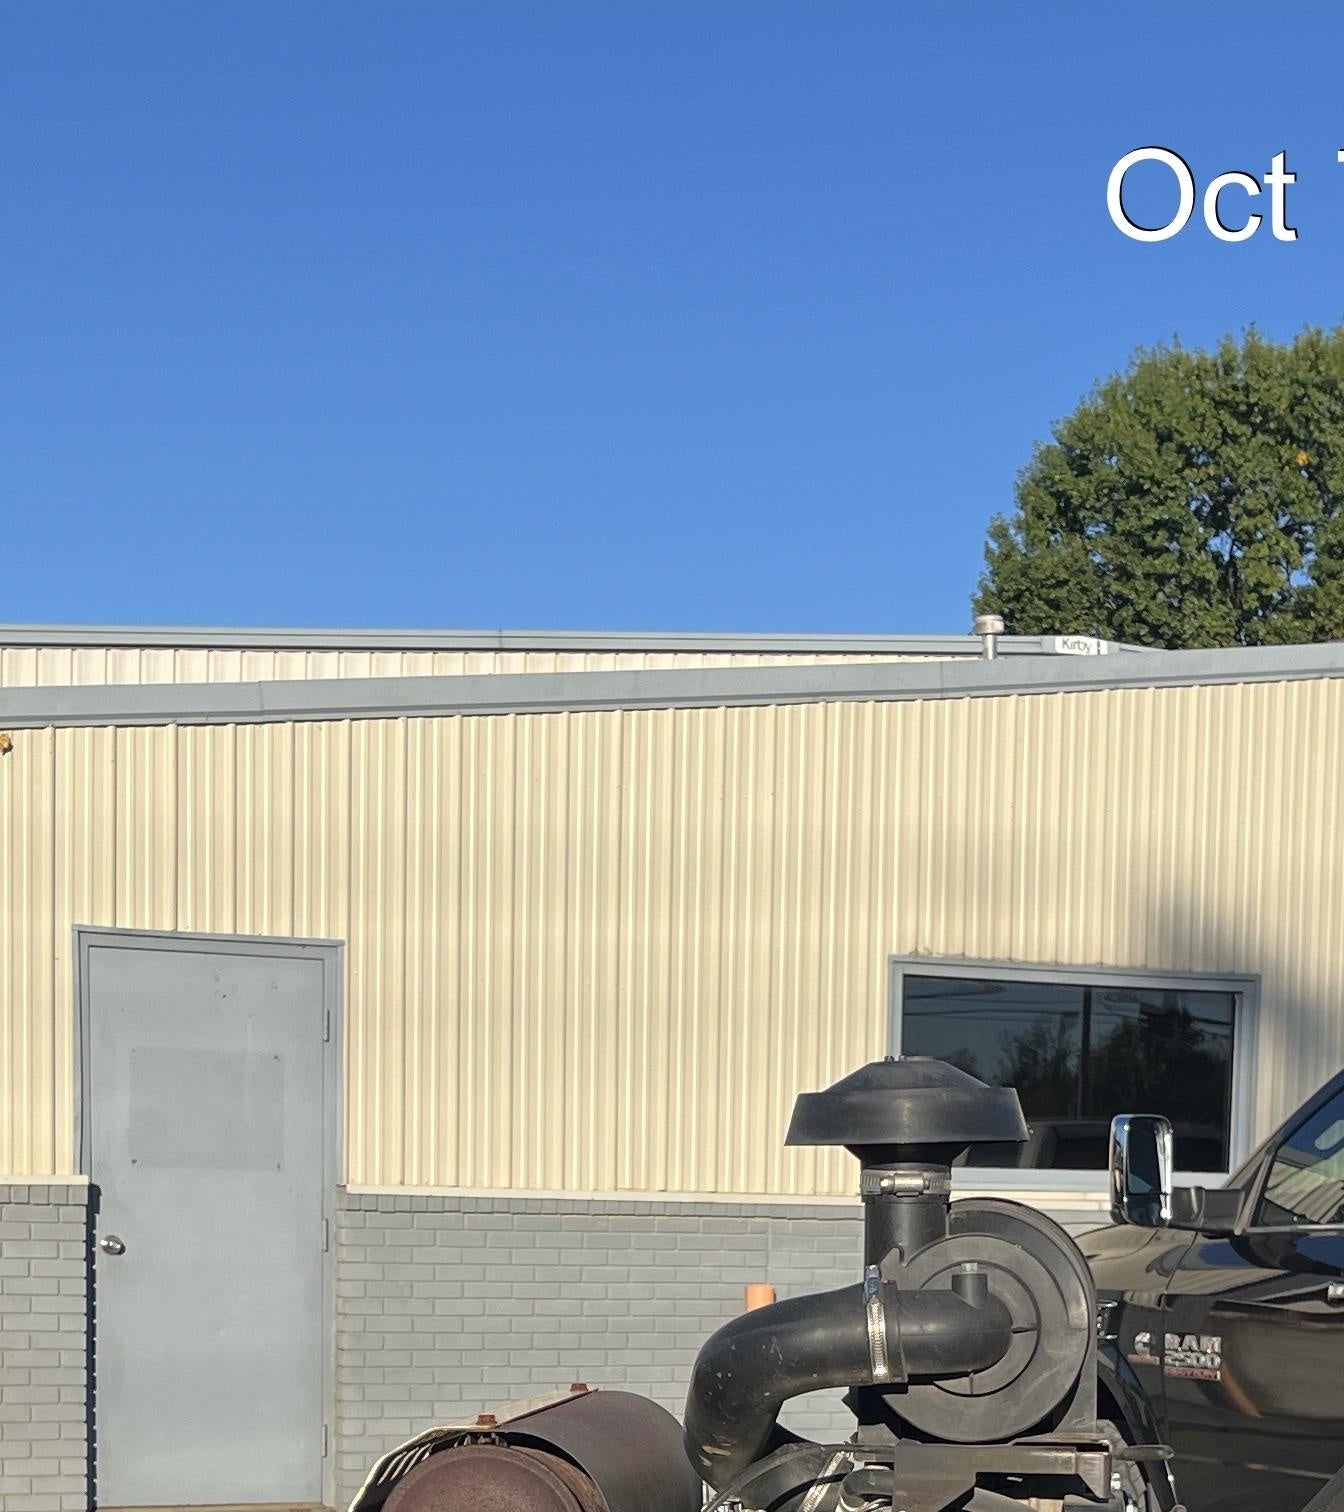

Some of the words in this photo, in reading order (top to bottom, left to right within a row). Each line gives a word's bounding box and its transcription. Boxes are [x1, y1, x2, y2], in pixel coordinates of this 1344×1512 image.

[1061, 638, 1093, 654] Kirby
[1164, 1333, 1221, 1354] RAM
[1164, 1350, 1221, 1369] 2500
